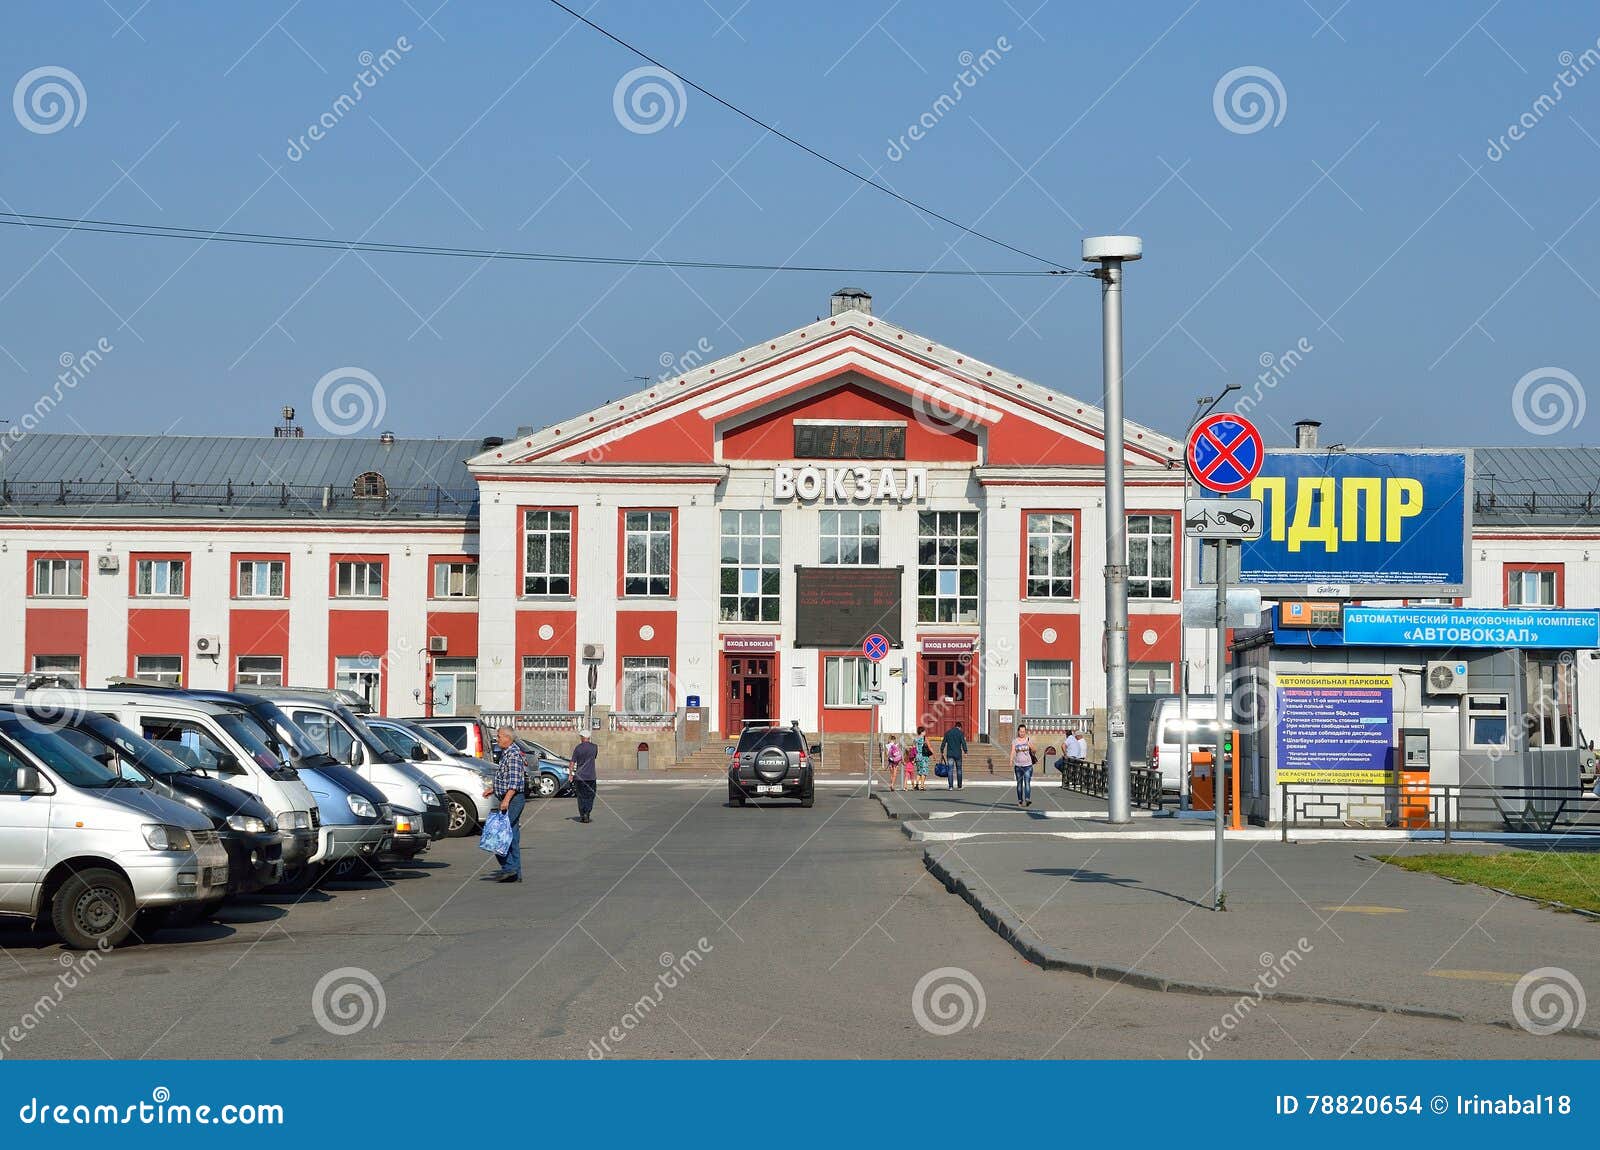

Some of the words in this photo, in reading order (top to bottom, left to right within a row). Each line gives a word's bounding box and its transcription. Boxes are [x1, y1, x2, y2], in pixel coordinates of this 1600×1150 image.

[774, 466, 928, 500] ВОКЗАЛ
[1348, 614, 1448, 625] АВТОМАТИЧЕСКИЙ
[1451, 615, 1534, 625] ПАРКОВОЧНЫЙ
[1537, 617, 1596, 626] КОМПЛЕКС
[1403, 627, 1539, 642] «АВТОВОКЗАЛ»
